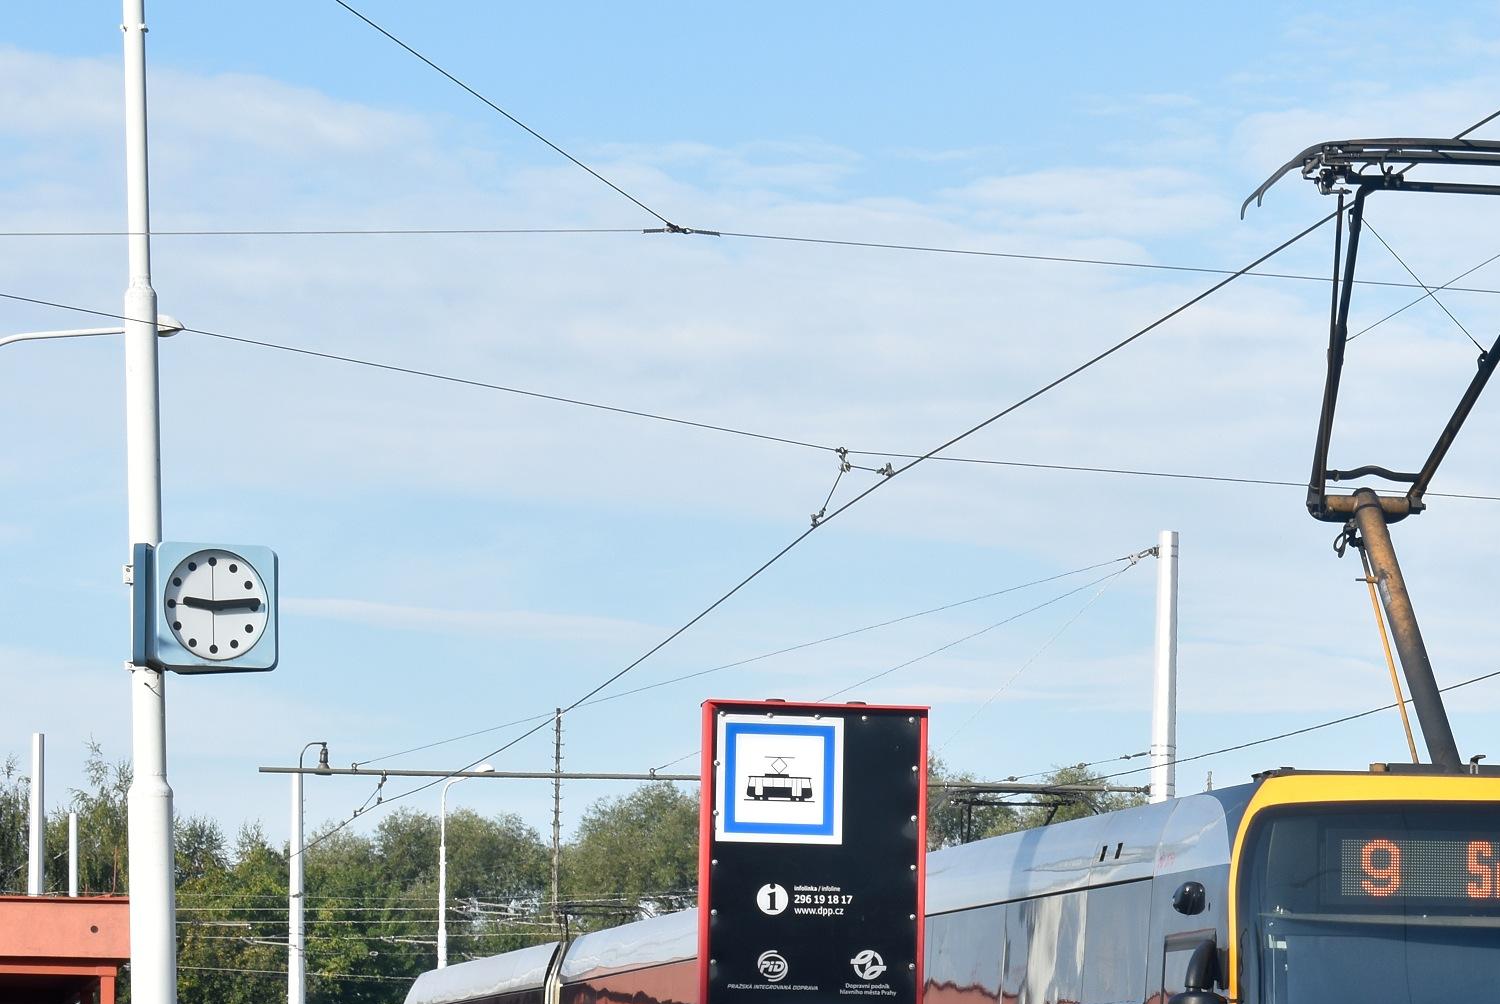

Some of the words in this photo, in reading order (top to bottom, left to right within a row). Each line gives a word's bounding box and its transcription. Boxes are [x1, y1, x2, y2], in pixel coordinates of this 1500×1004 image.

[1361, 839, 1400, 896] 9
[794, 894, 812, 904] 296
[814, 895, 826, 904] 19
[828, 895, 839, 905] 18
[841, 895, 853, 905] 17
[794, 906, 844, 916] www.dpp.cz
[881, 989, 897, 997] Prahy
